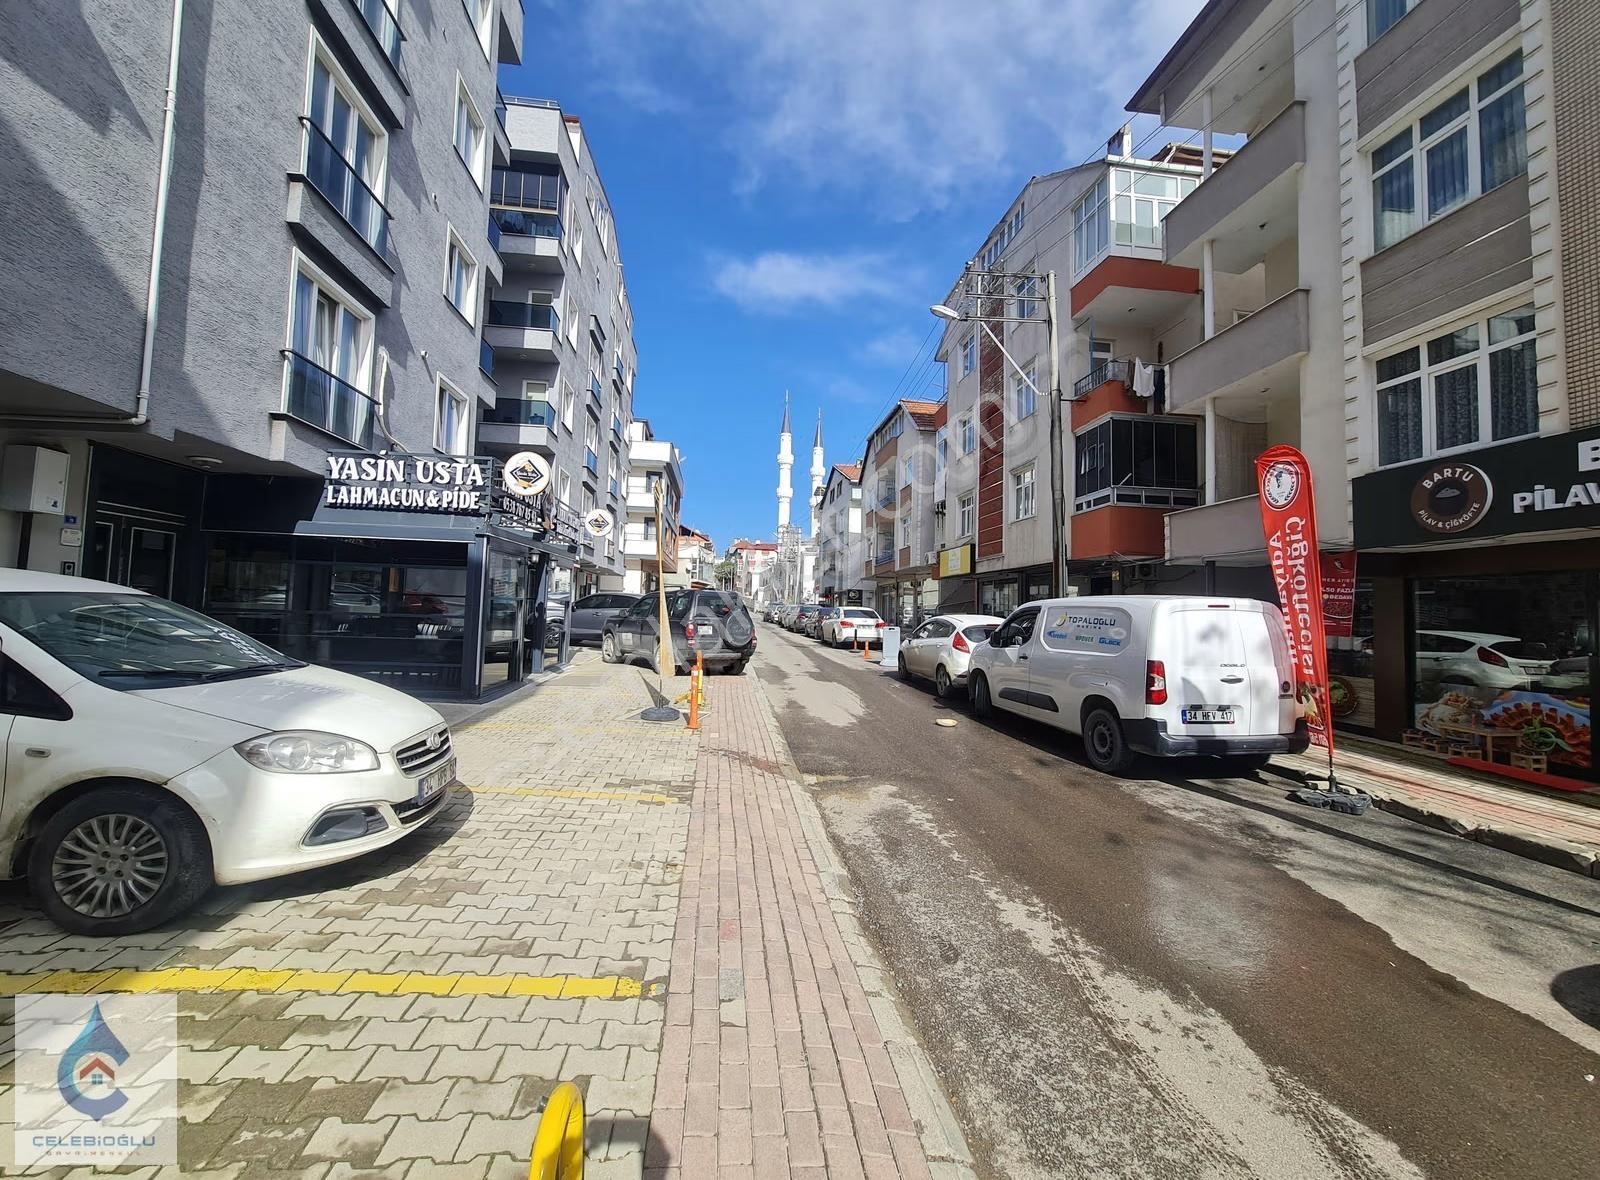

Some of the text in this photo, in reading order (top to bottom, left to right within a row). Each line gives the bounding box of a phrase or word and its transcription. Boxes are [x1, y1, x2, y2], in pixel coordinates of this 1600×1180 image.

[326, 450, 484, 486] YASİN USTA
[1422, 468, 1474, 489] BARTU
[1418, 509, 1437, 526] PİLAV
[1187, 712, 1197, 720] 34
[1220, 711, 1233, 720] 417
